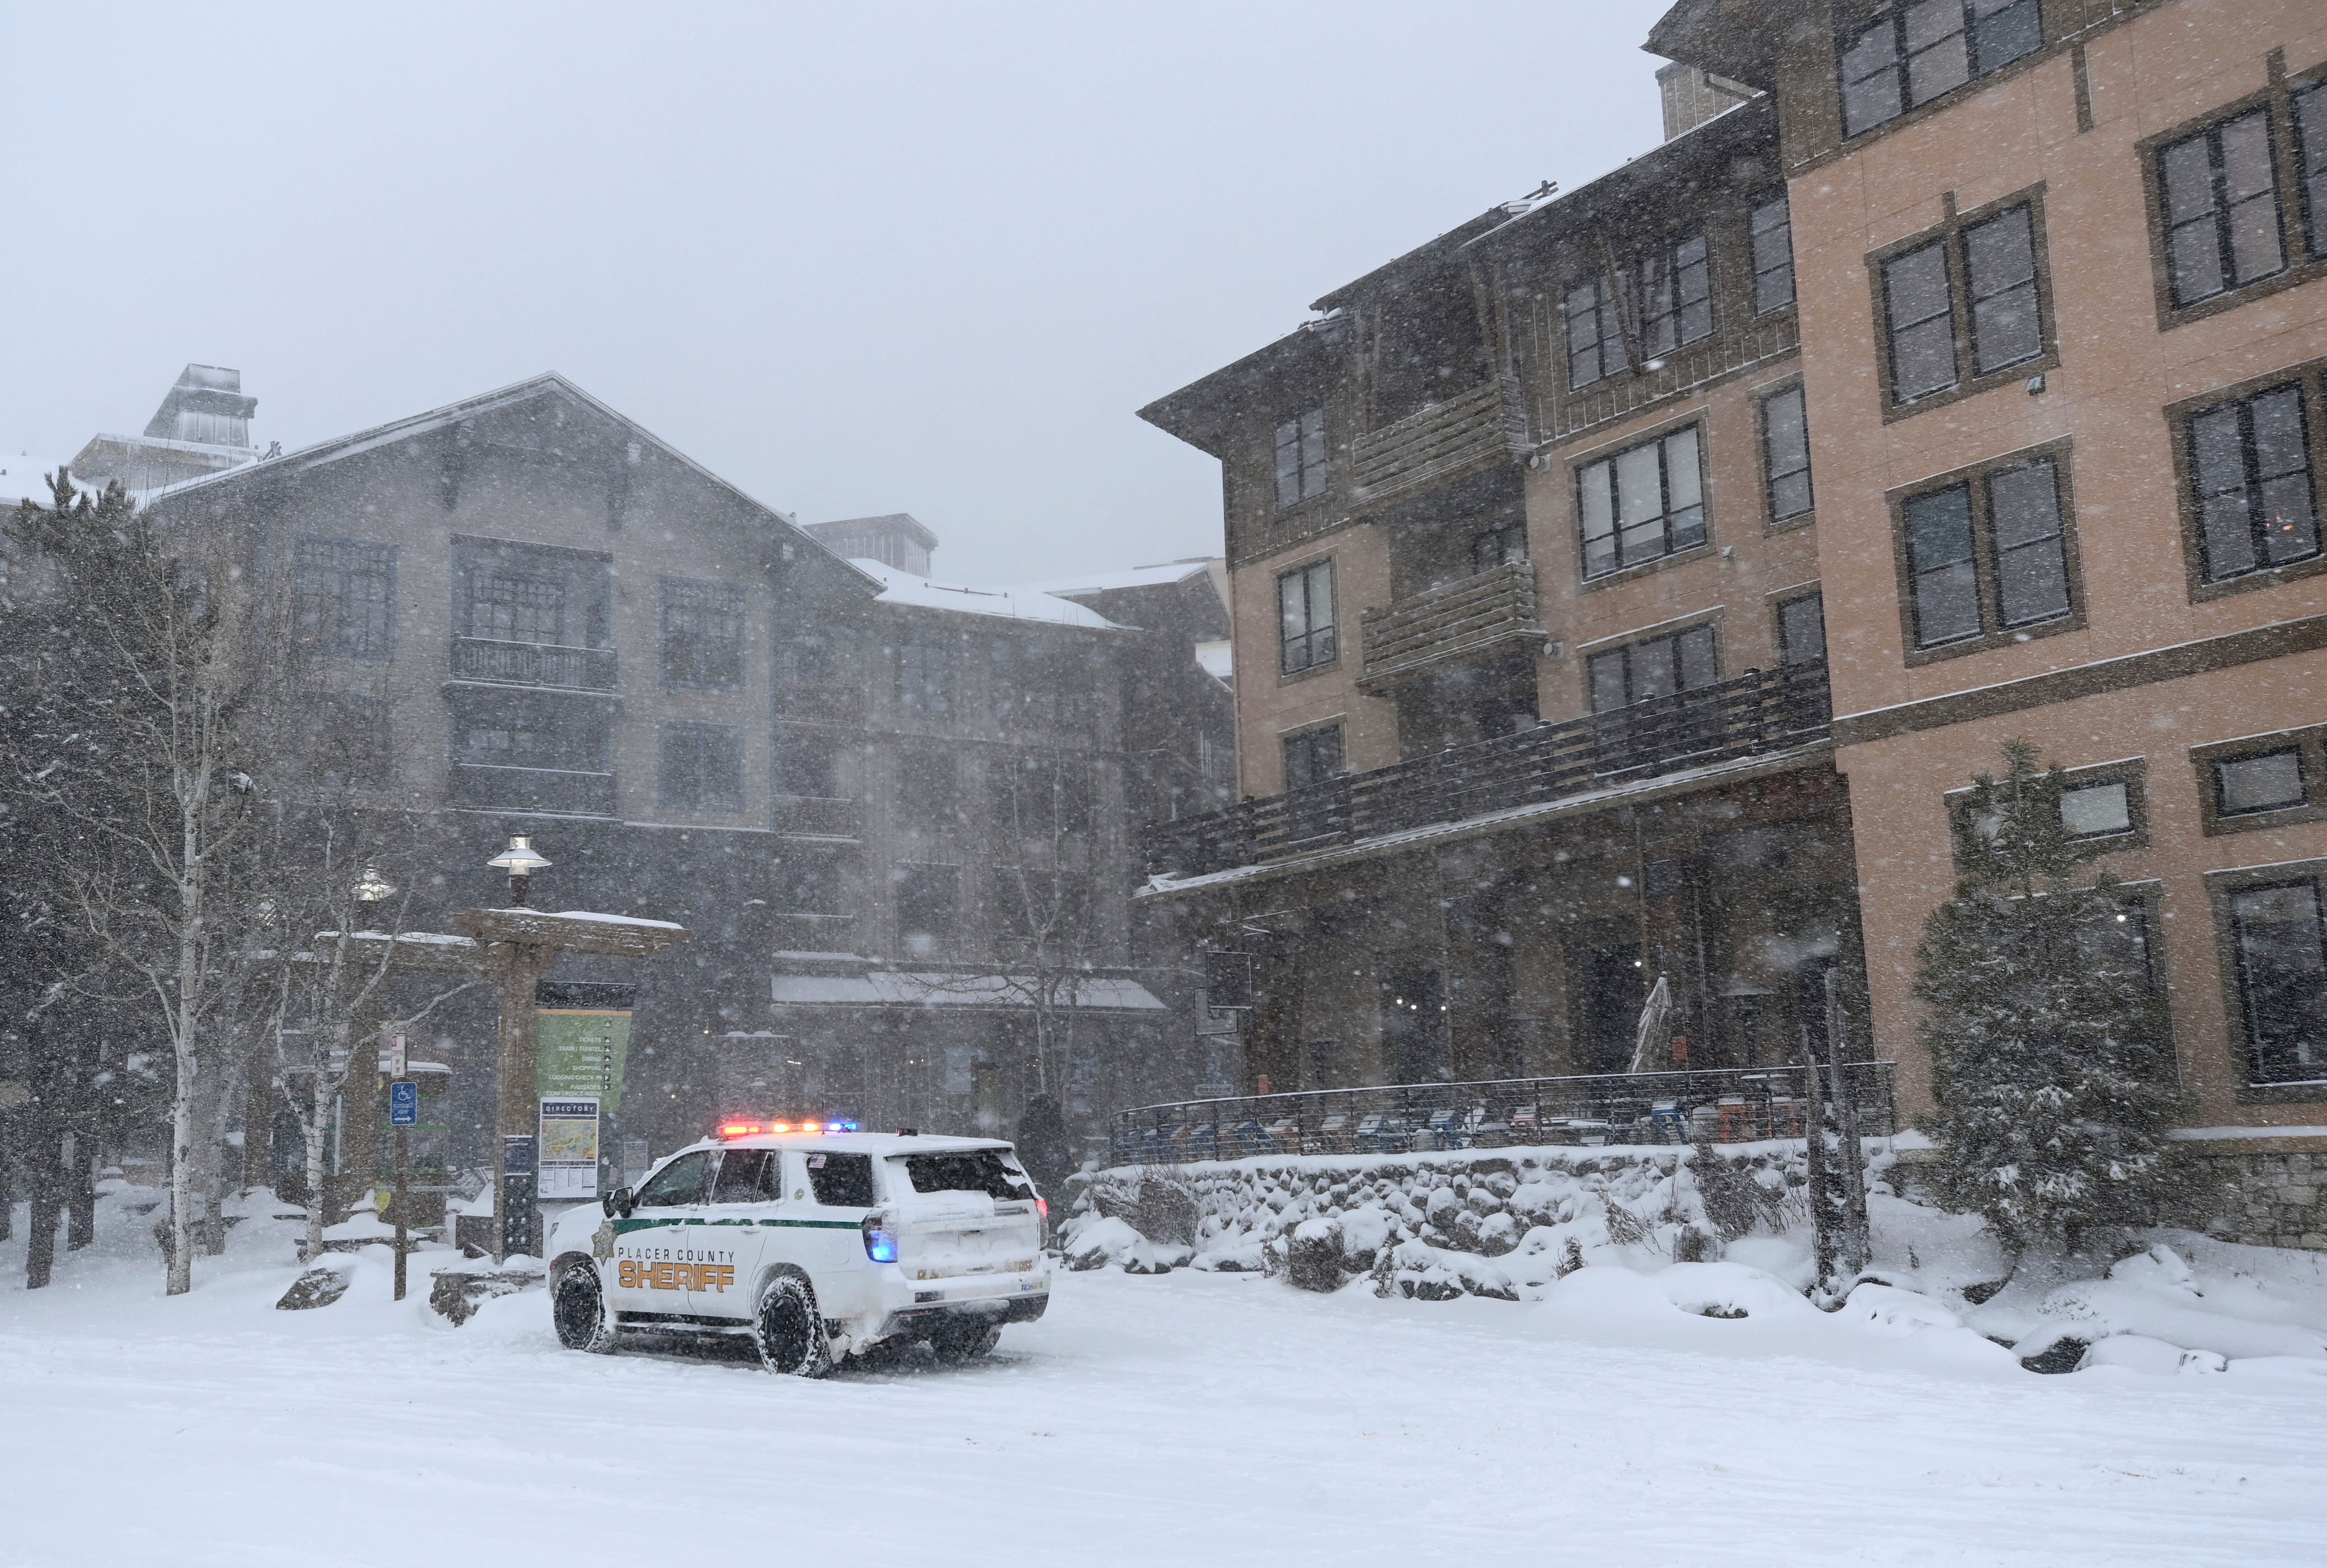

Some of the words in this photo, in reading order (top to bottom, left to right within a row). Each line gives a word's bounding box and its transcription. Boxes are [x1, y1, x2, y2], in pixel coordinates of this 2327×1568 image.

[619, 1247, 669, 1260] PLACER
[678, 1250, 734, 1263] COUNTY
[619, 1260, 734, 1292] SHERIFF
